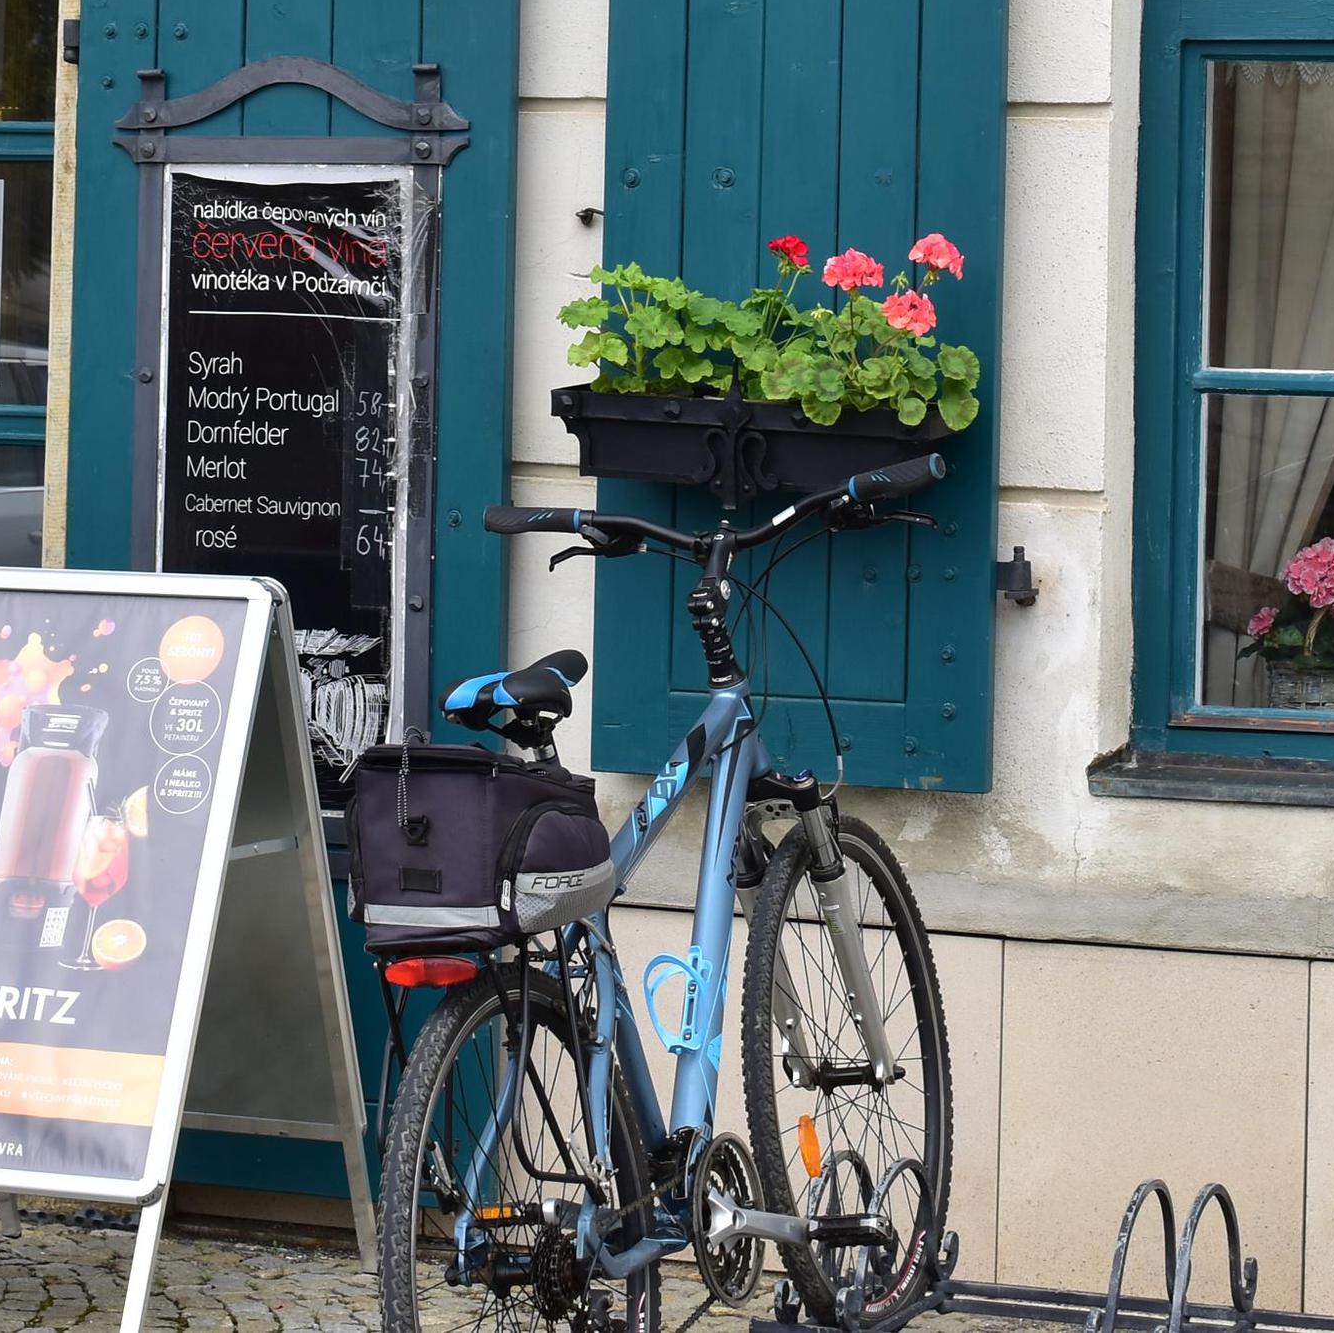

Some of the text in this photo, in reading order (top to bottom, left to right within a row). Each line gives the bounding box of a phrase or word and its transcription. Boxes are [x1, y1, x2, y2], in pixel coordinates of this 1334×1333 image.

[193, 200, 257, 220] nabídka
[262, 201, 356, 229] čepovaných
[191, 222, 388, 268] červená vína
[191, 267, 387, 297] vinotéka v Podzámčí
[187, 350, 243, 380] Syrah
[188, 385, 340, 418] Modrý Portugal
[187, 419, 289, 446] Dornfelder
[186, 454, 247, 480] Merlot
[184, 492, 341, 520] Cabernet Sauvignon
[195, 525, 238, 549] rosé
[168, 696, 209, 708] ČEPOVANÝ
[176, 718, 204, 733] 30L
[169, 780, 201, 788] NEALKO
[172, 768, 197, 778] MÁME
[531, 873, 585, 890] FORCE
